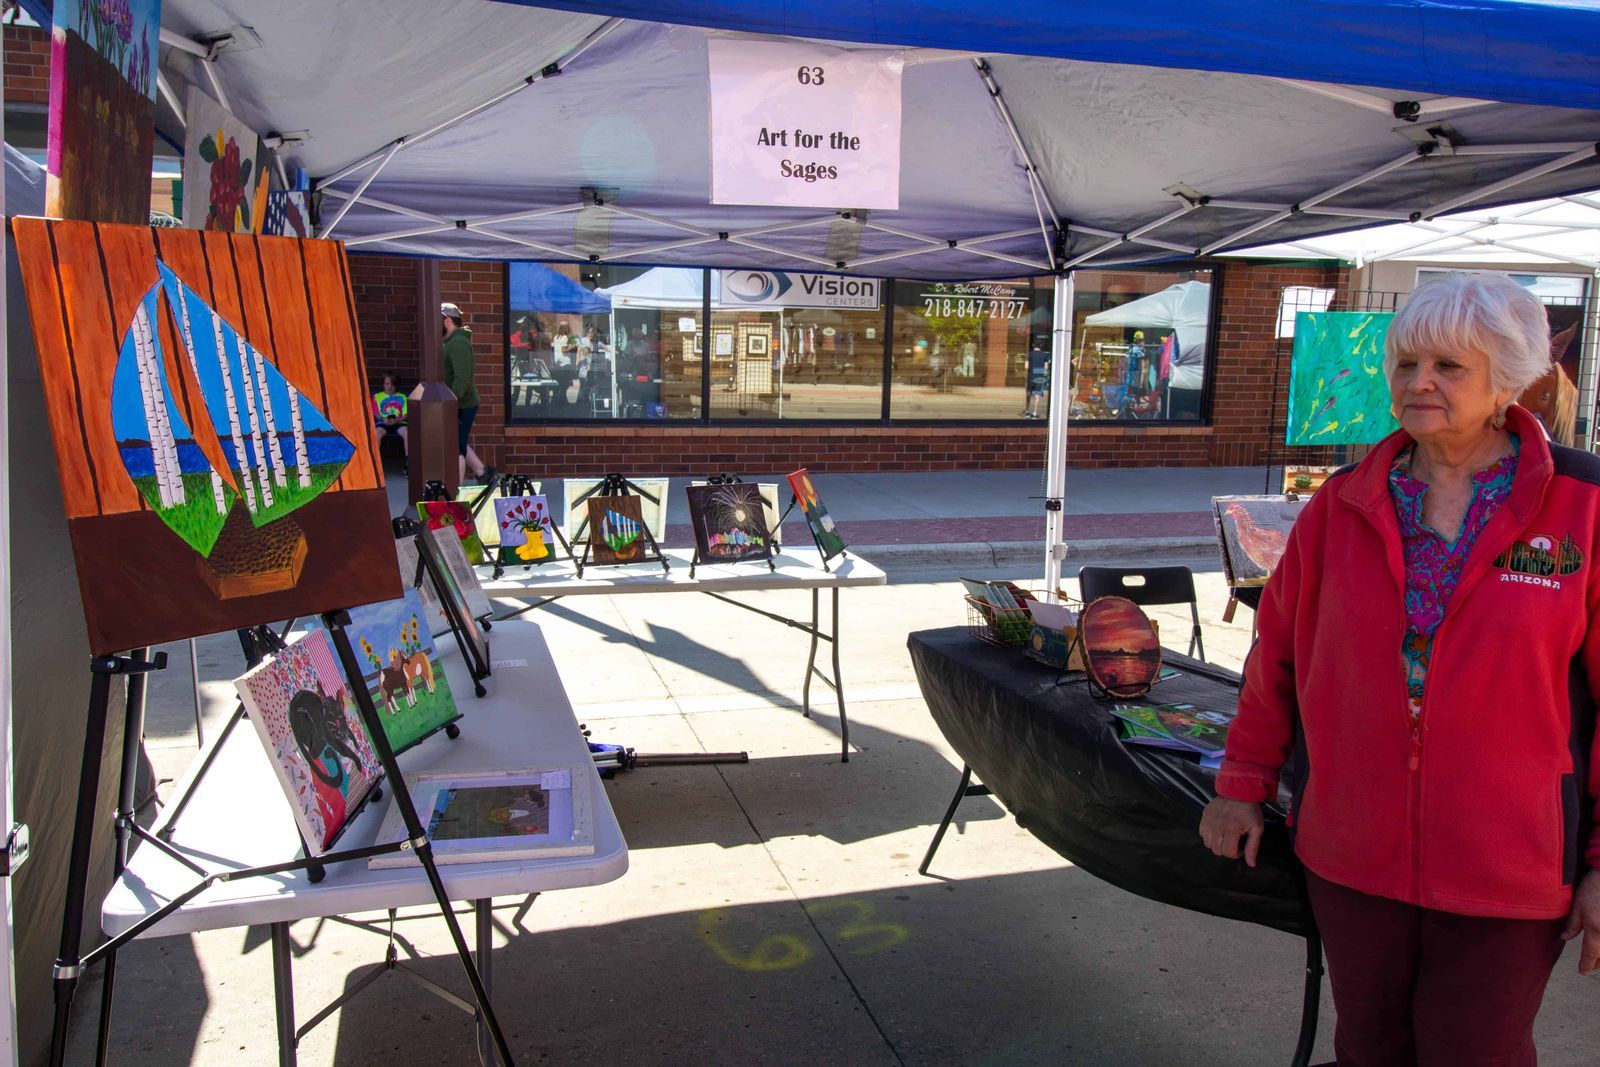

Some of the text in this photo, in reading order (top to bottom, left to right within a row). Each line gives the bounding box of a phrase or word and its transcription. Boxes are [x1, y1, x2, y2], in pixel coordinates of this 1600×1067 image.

[798, 66, 824, 85] 63
[757, 128, 860, 150] Art for the
[781, 159, 837, 182] Sages
[800, 275, 873, 296] Vision
[935, 283, 949, 292] Dr.
[953, 284, 978, 293] Robert
[827, 298, 872, 306] CENTERS
[924, 298, 1024, 319] 218-847-2127
[1501, 574, 1560, 589] ARIZONA
